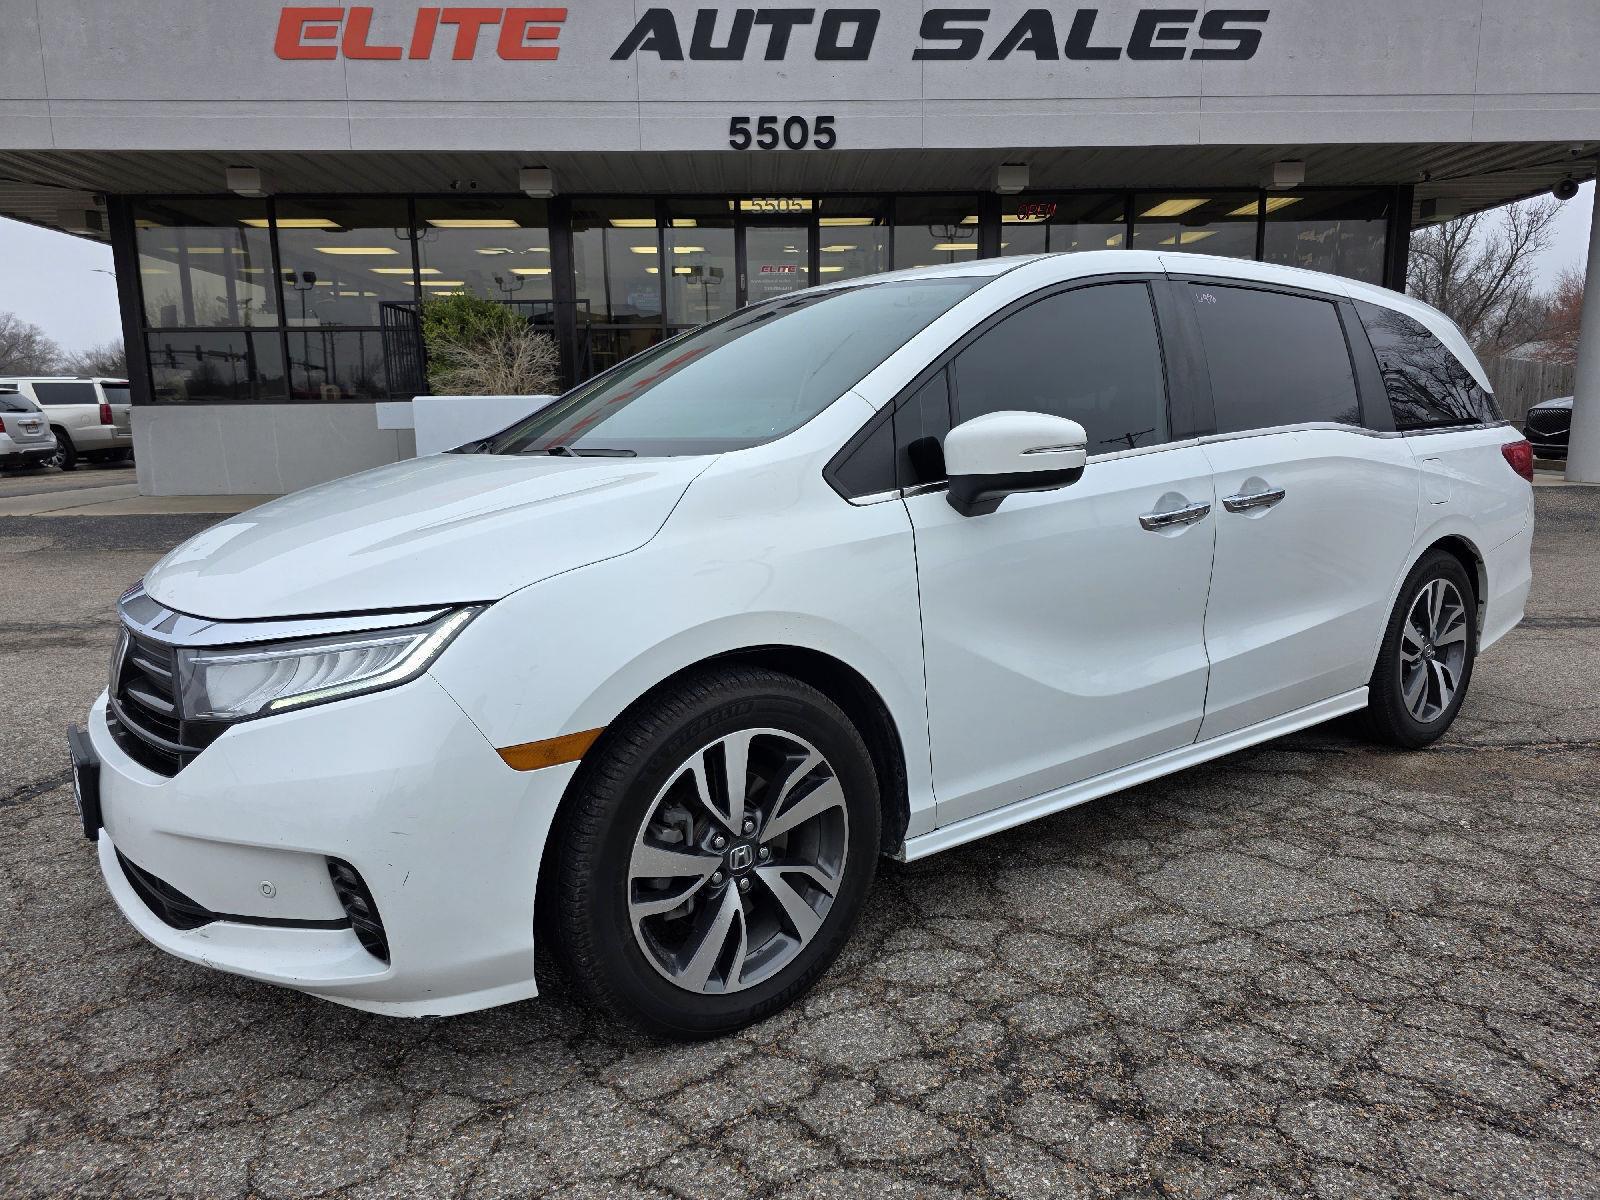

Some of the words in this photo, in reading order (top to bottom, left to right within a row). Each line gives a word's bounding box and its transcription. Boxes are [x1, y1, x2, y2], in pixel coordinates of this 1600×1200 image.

[274, 7, 567, 61] ELITE
[610, 8, 881, 61] AUTO
[911, 9, 1270, 61] SALES
[729, 115, 837, 150] 5505
[751, 197, 803, 213] 5505
[1017, 202, 1057, 220] OPEN
[760, 265, 797, 273] ELITE
